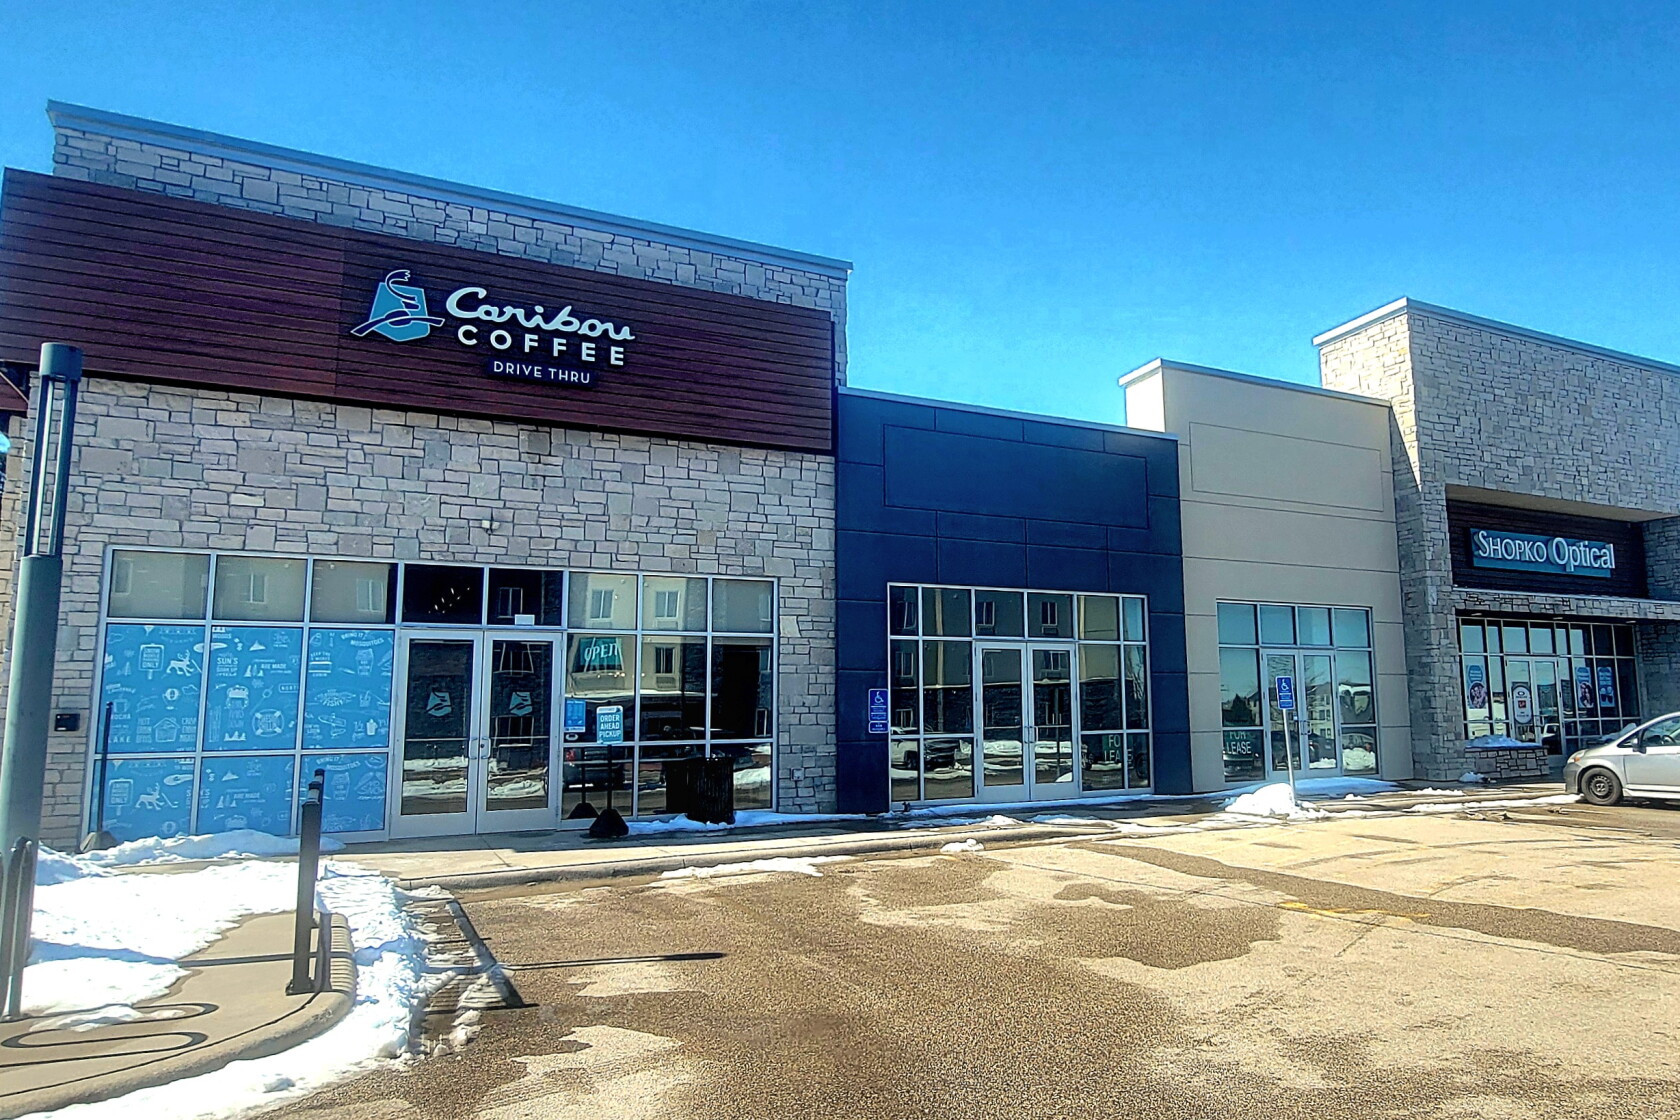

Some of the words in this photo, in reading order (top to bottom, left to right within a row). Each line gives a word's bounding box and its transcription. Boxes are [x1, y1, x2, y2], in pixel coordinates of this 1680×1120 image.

[446, 286, 635, 340] Caribou
[457, 324, 625, 366] COFFEE
[493, 360, 543, 379] DRIVE
[548, 367, 590, 384] THRU
[1478, 530, 1547, 562] SHOPKO
[1552, 537, 1615, 571] Optical
[584, 643, 618, 661] OPEN
[600, 714, 620, 723] ORDER
[600, 722, 620, 730] AHEAD
[599, 730, 622, 738] PICKUP
[1226, 741, 1252, 755] LEASE
